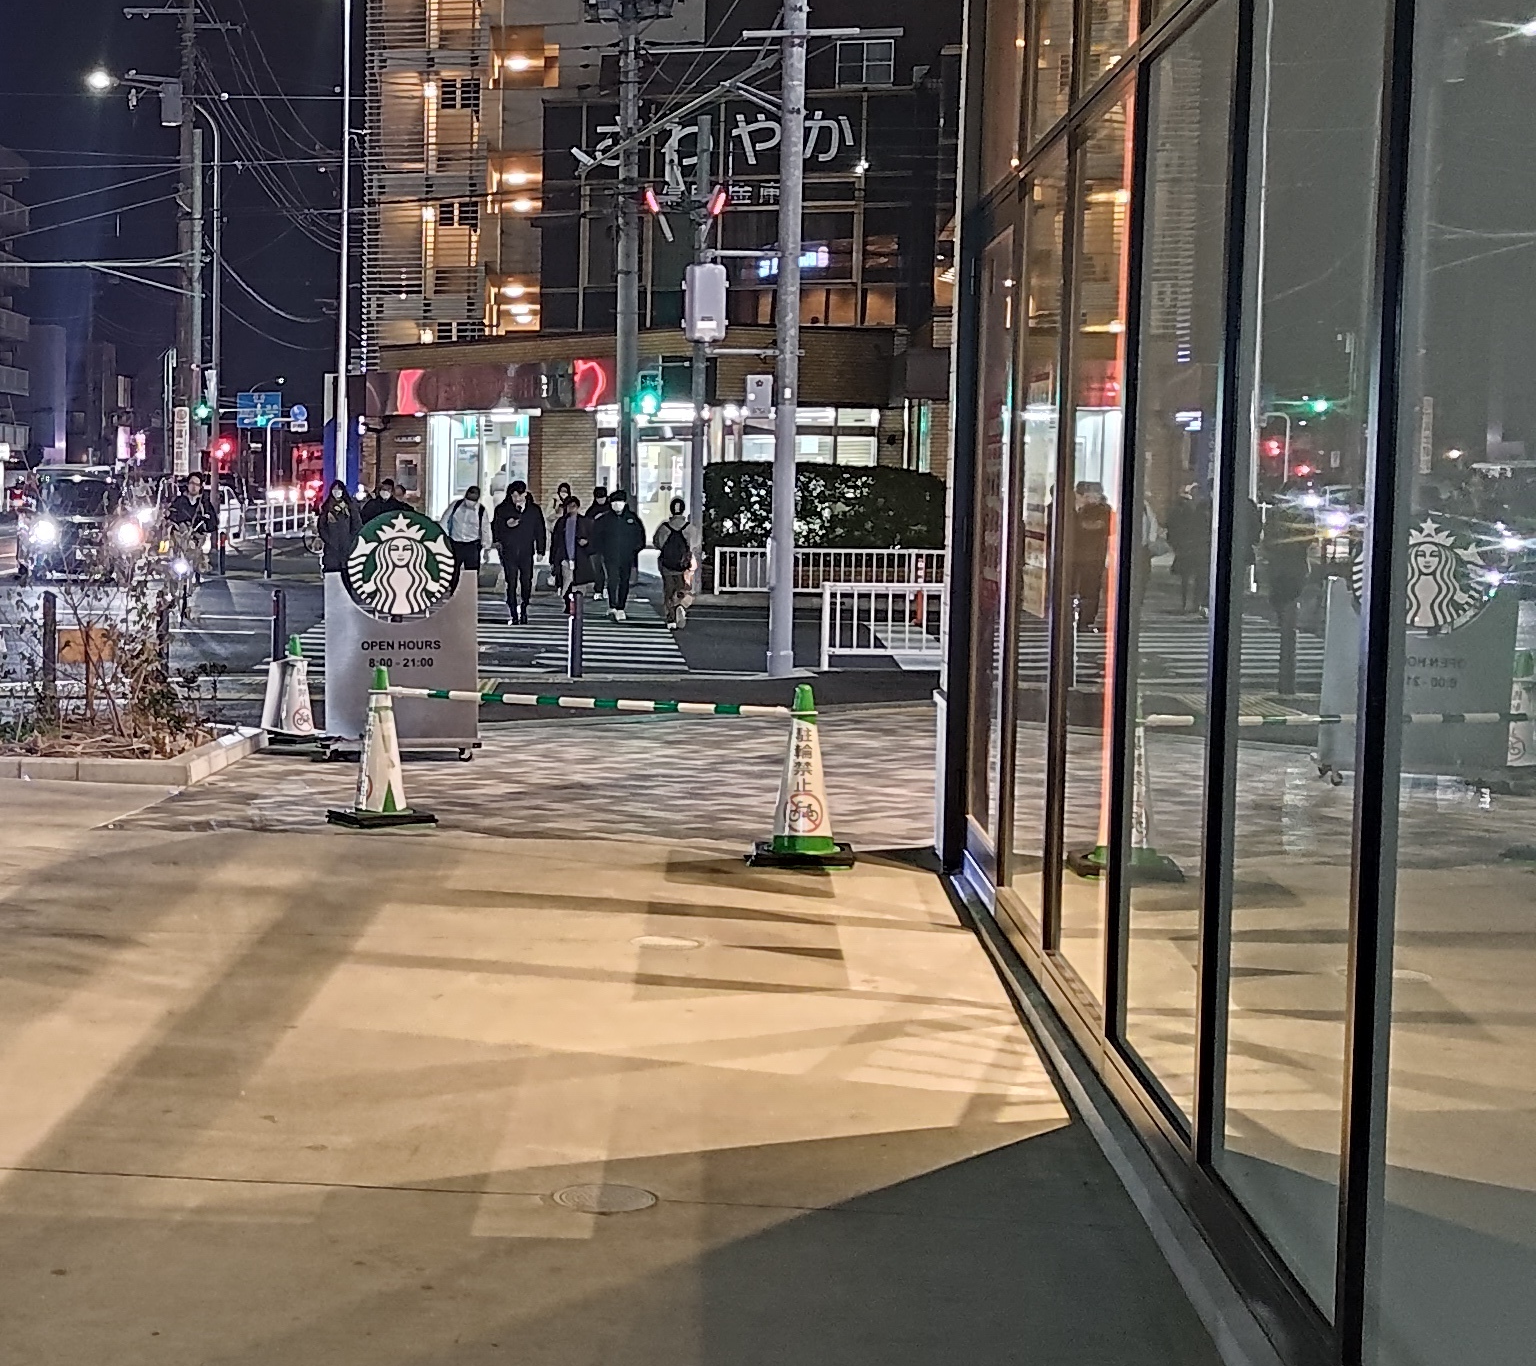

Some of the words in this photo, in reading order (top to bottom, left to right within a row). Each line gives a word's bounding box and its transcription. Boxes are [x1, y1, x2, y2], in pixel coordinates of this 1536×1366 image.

[361, 641, 394, 651] OPEN
[398, 640, 442, 650] HOURS
[368, 658, 393, 668] 8:00
[402, 657, 434, 668] 21:00
[793, 726, 813, 793] 駐輪禁止
